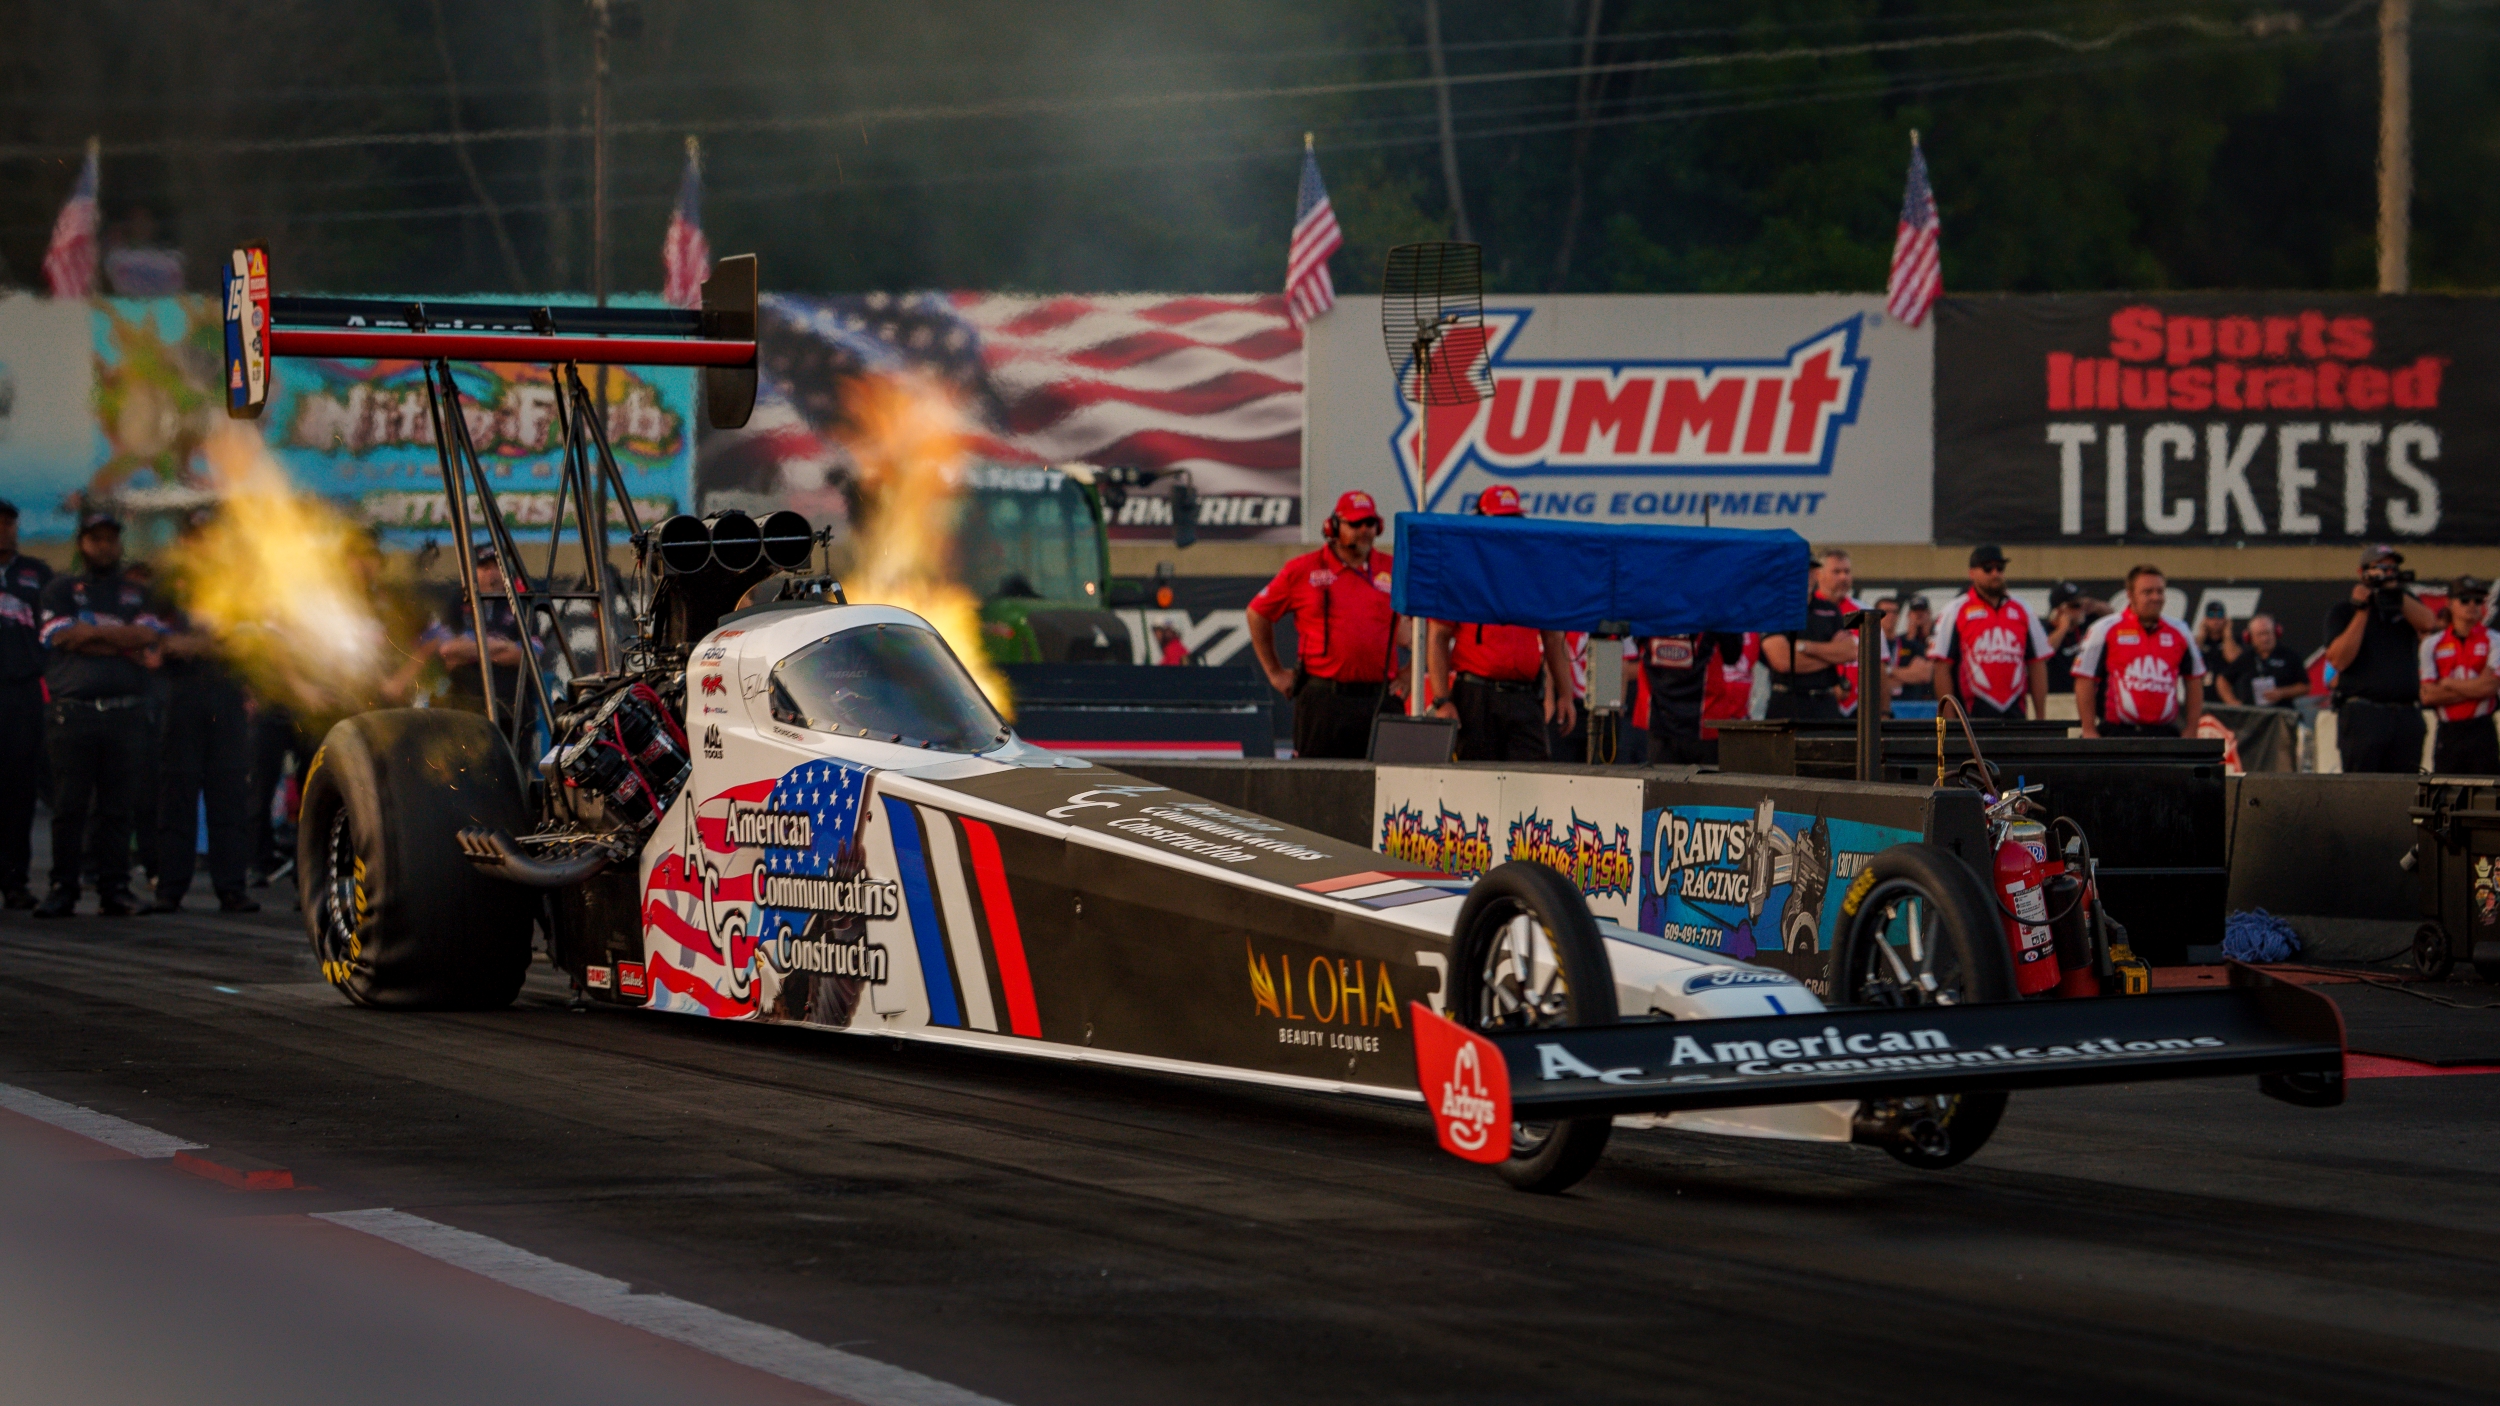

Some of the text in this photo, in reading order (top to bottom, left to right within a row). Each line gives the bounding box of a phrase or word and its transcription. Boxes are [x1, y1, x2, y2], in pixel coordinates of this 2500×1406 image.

[2109, 304, 2376, 365] Sports
[2046, 350, 2444, 411] Illustrated
[2045, 420, 2443, 537] TICKETS
[1117, 497, 1293, 525] AMRICA
[1608, 493, 1826, 516] EQUIPMENT
[702, 647, 727, 660] FORD
[705, 750, 723, 759] TOOLS
[725, 799, 812, 847] American
[1107, 817, 1258, 863] Construction
[1381, 802, 1490, 879] Nitro Fish
[1654, 810, 1746, 897] CRAW'S
[1681, 869, 1750, 903] RACING
[1664, 922, 1723, 947] 609-491-7171
[1246, 936, 1403, 1030] ALOHA
[1278, 1027, 1325, 1047] BEAUTY
[1669, 1026, 1952, 1067] American
[1734, 1034, 2228, 1076] Communications
